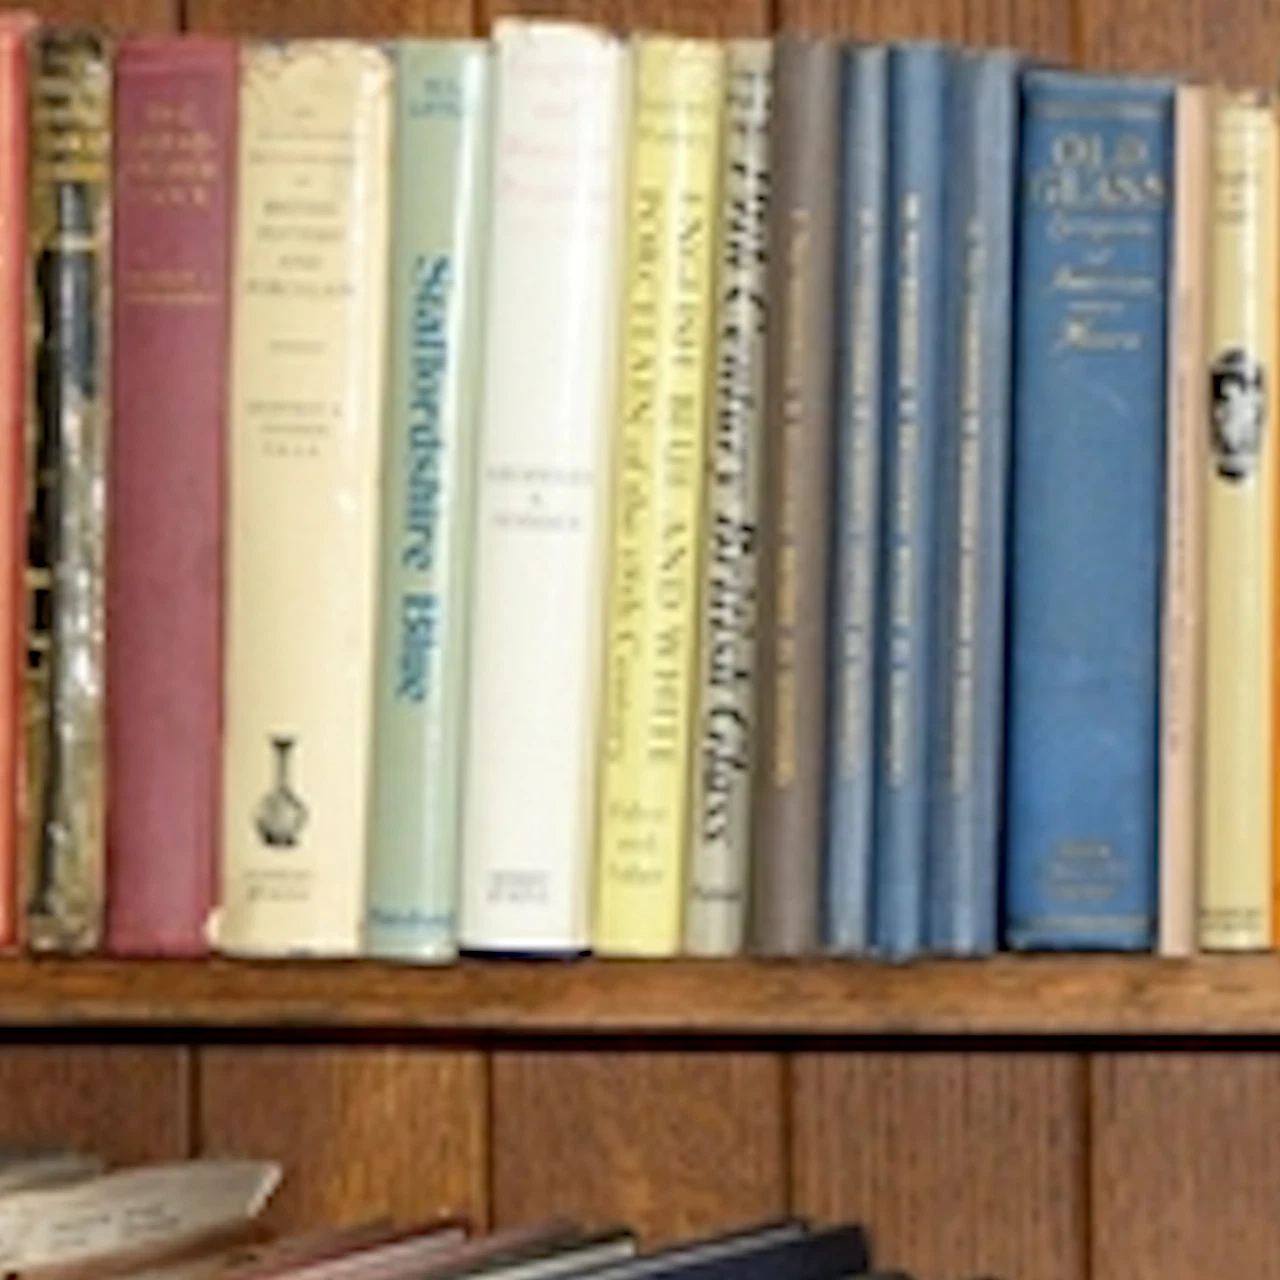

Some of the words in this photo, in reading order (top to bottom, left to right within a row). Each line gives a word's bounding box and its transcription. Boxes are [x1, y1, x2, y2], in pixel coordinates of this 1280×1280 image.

[1030, 169, 1166, 206] GLASS
[1052, 133, 1148, 162] OLD
[627, 188, 663, 424] PORCELAIN
[675, 190, 705, 368] ENGLISH
[401, 253, 452, 570] Staffordshire
[666, 393, 695, 488] BLUE
[717, 284, 767, 484] Century
[660, 522, 688, 611] AND
[708, 515, 757, 689] British
[394, 591, 439, 706] Blue
[649, 623, 686, 764] WHITE
[700, 707, 751, 845] Glass
